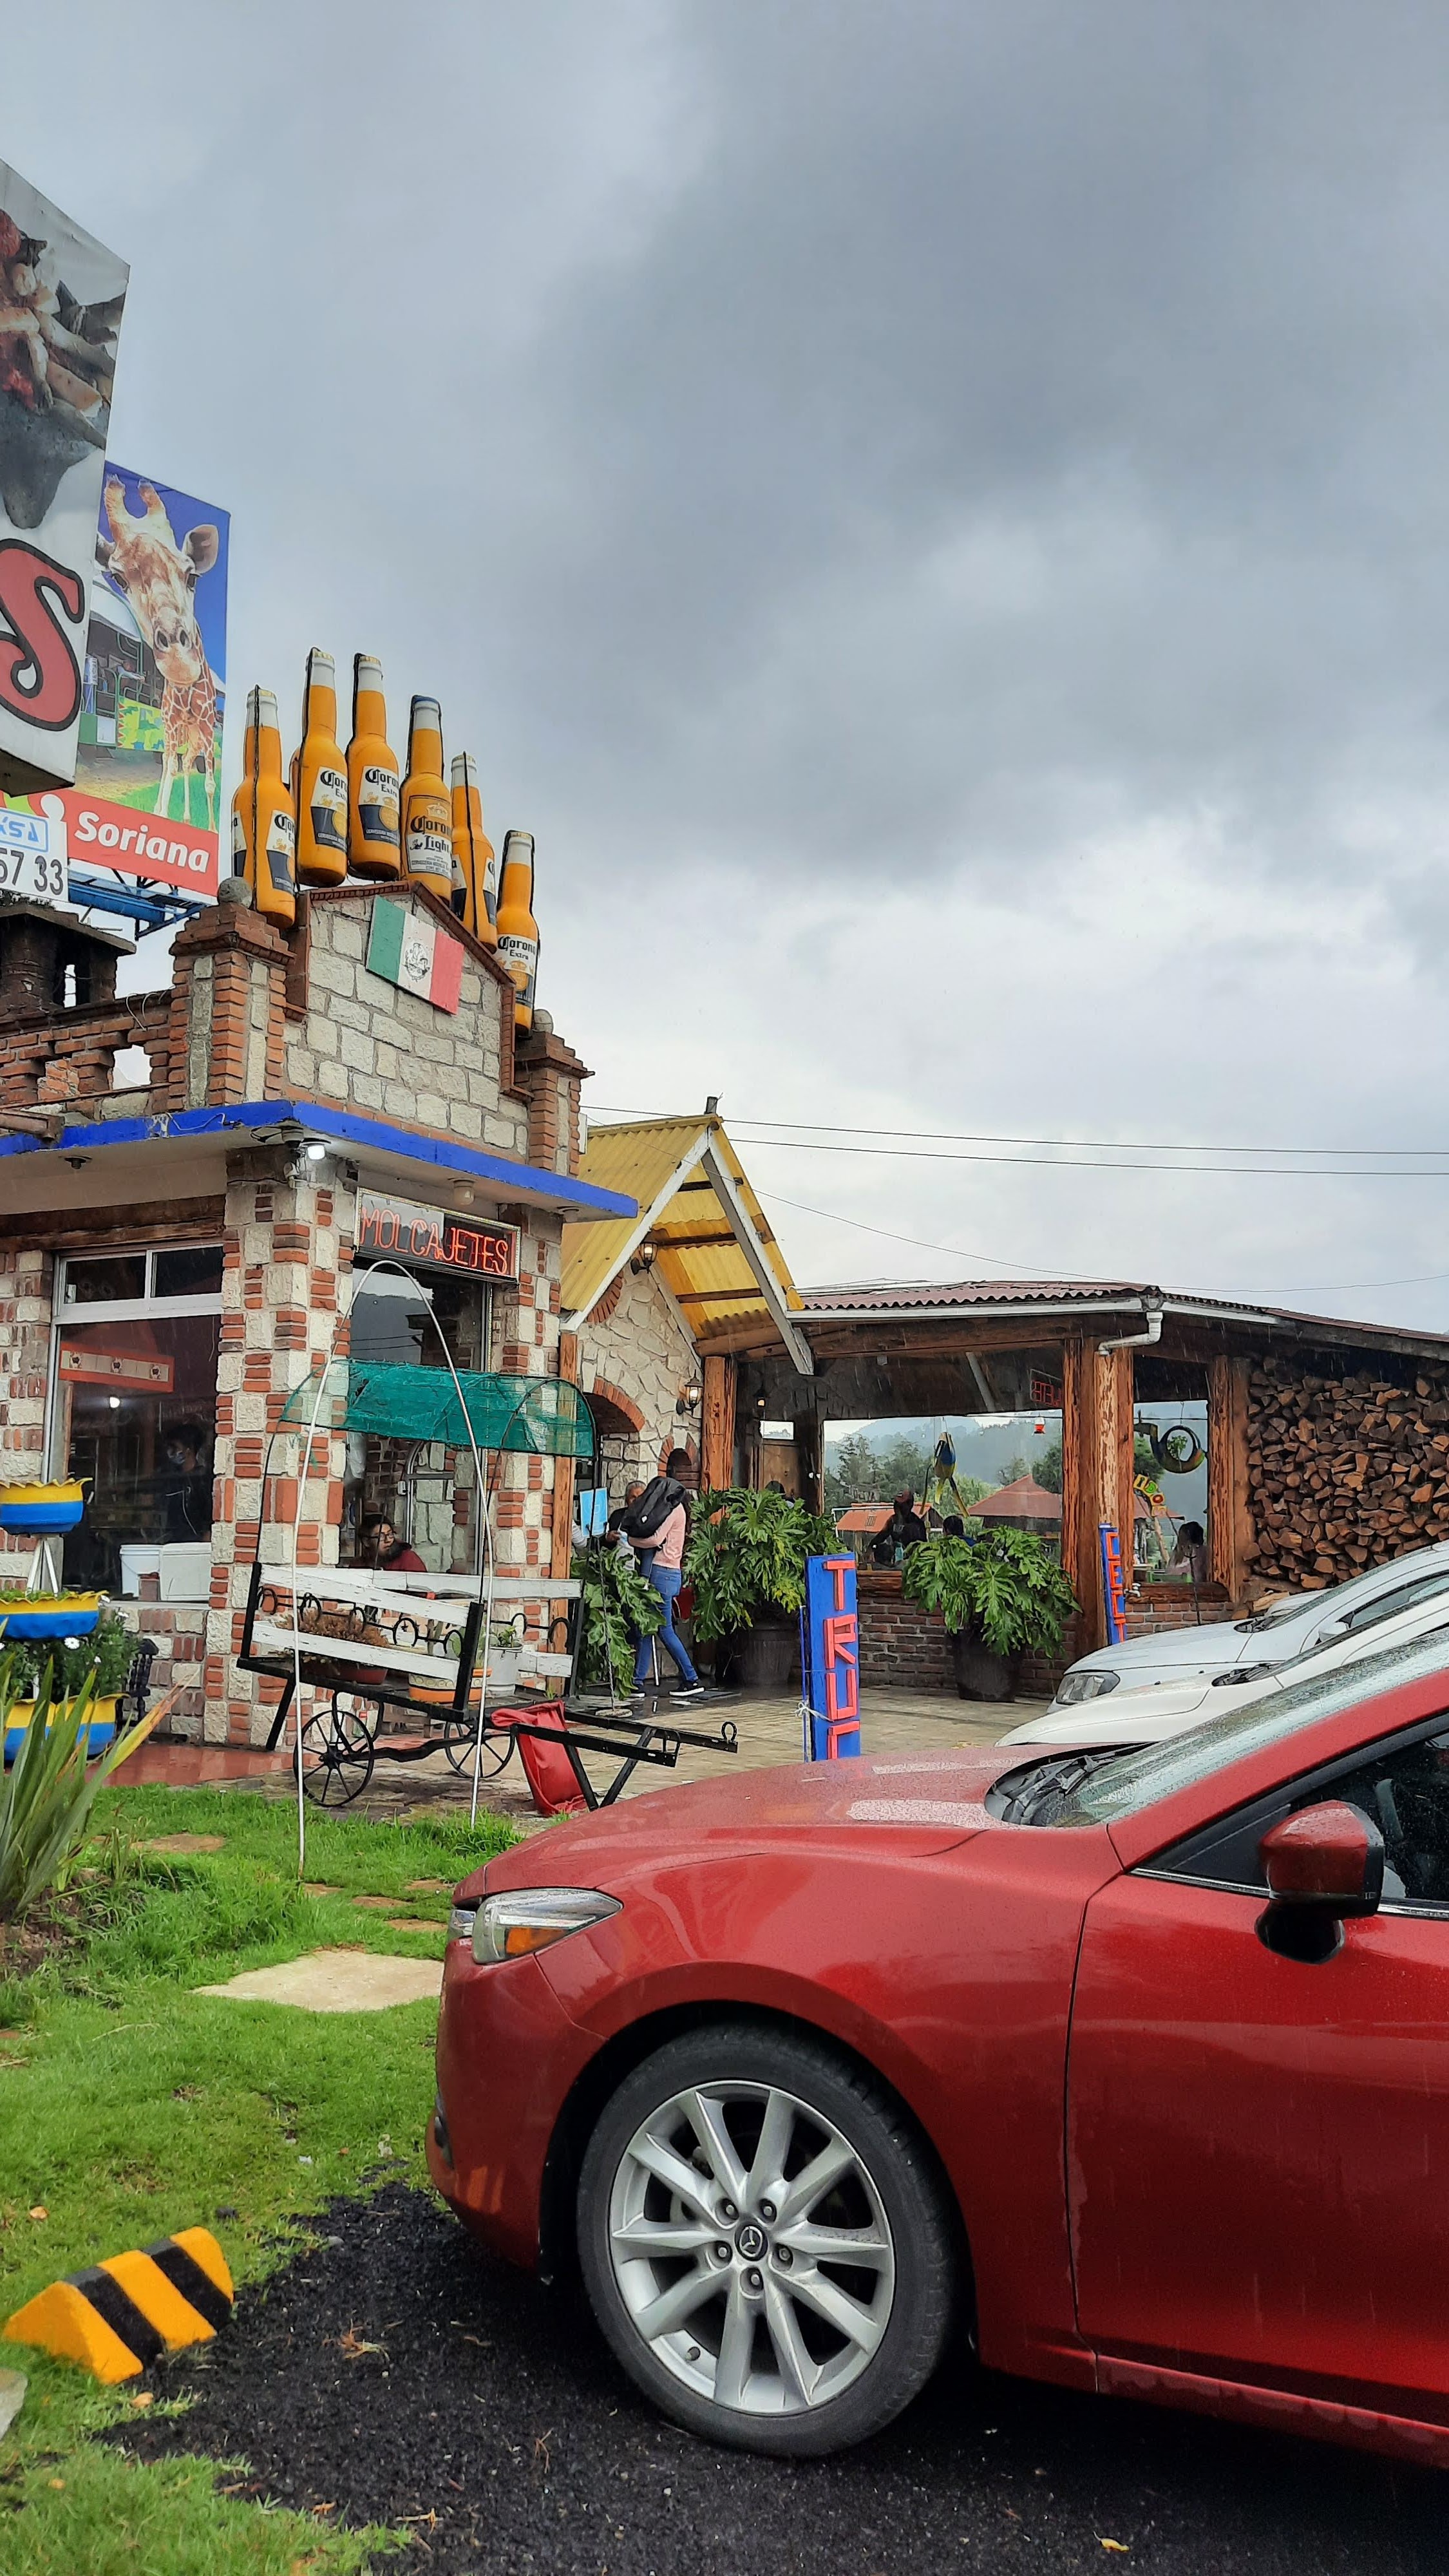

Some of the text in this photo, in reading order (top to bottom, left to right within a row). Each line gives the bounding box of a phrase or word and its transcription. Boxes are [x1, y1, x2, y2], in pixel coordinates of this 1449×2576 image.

[75, 811, 210, 874] Soriana
[34, 855, 63, 895] 33
[359, 1206, 509, 1275] MOLCAJETES
